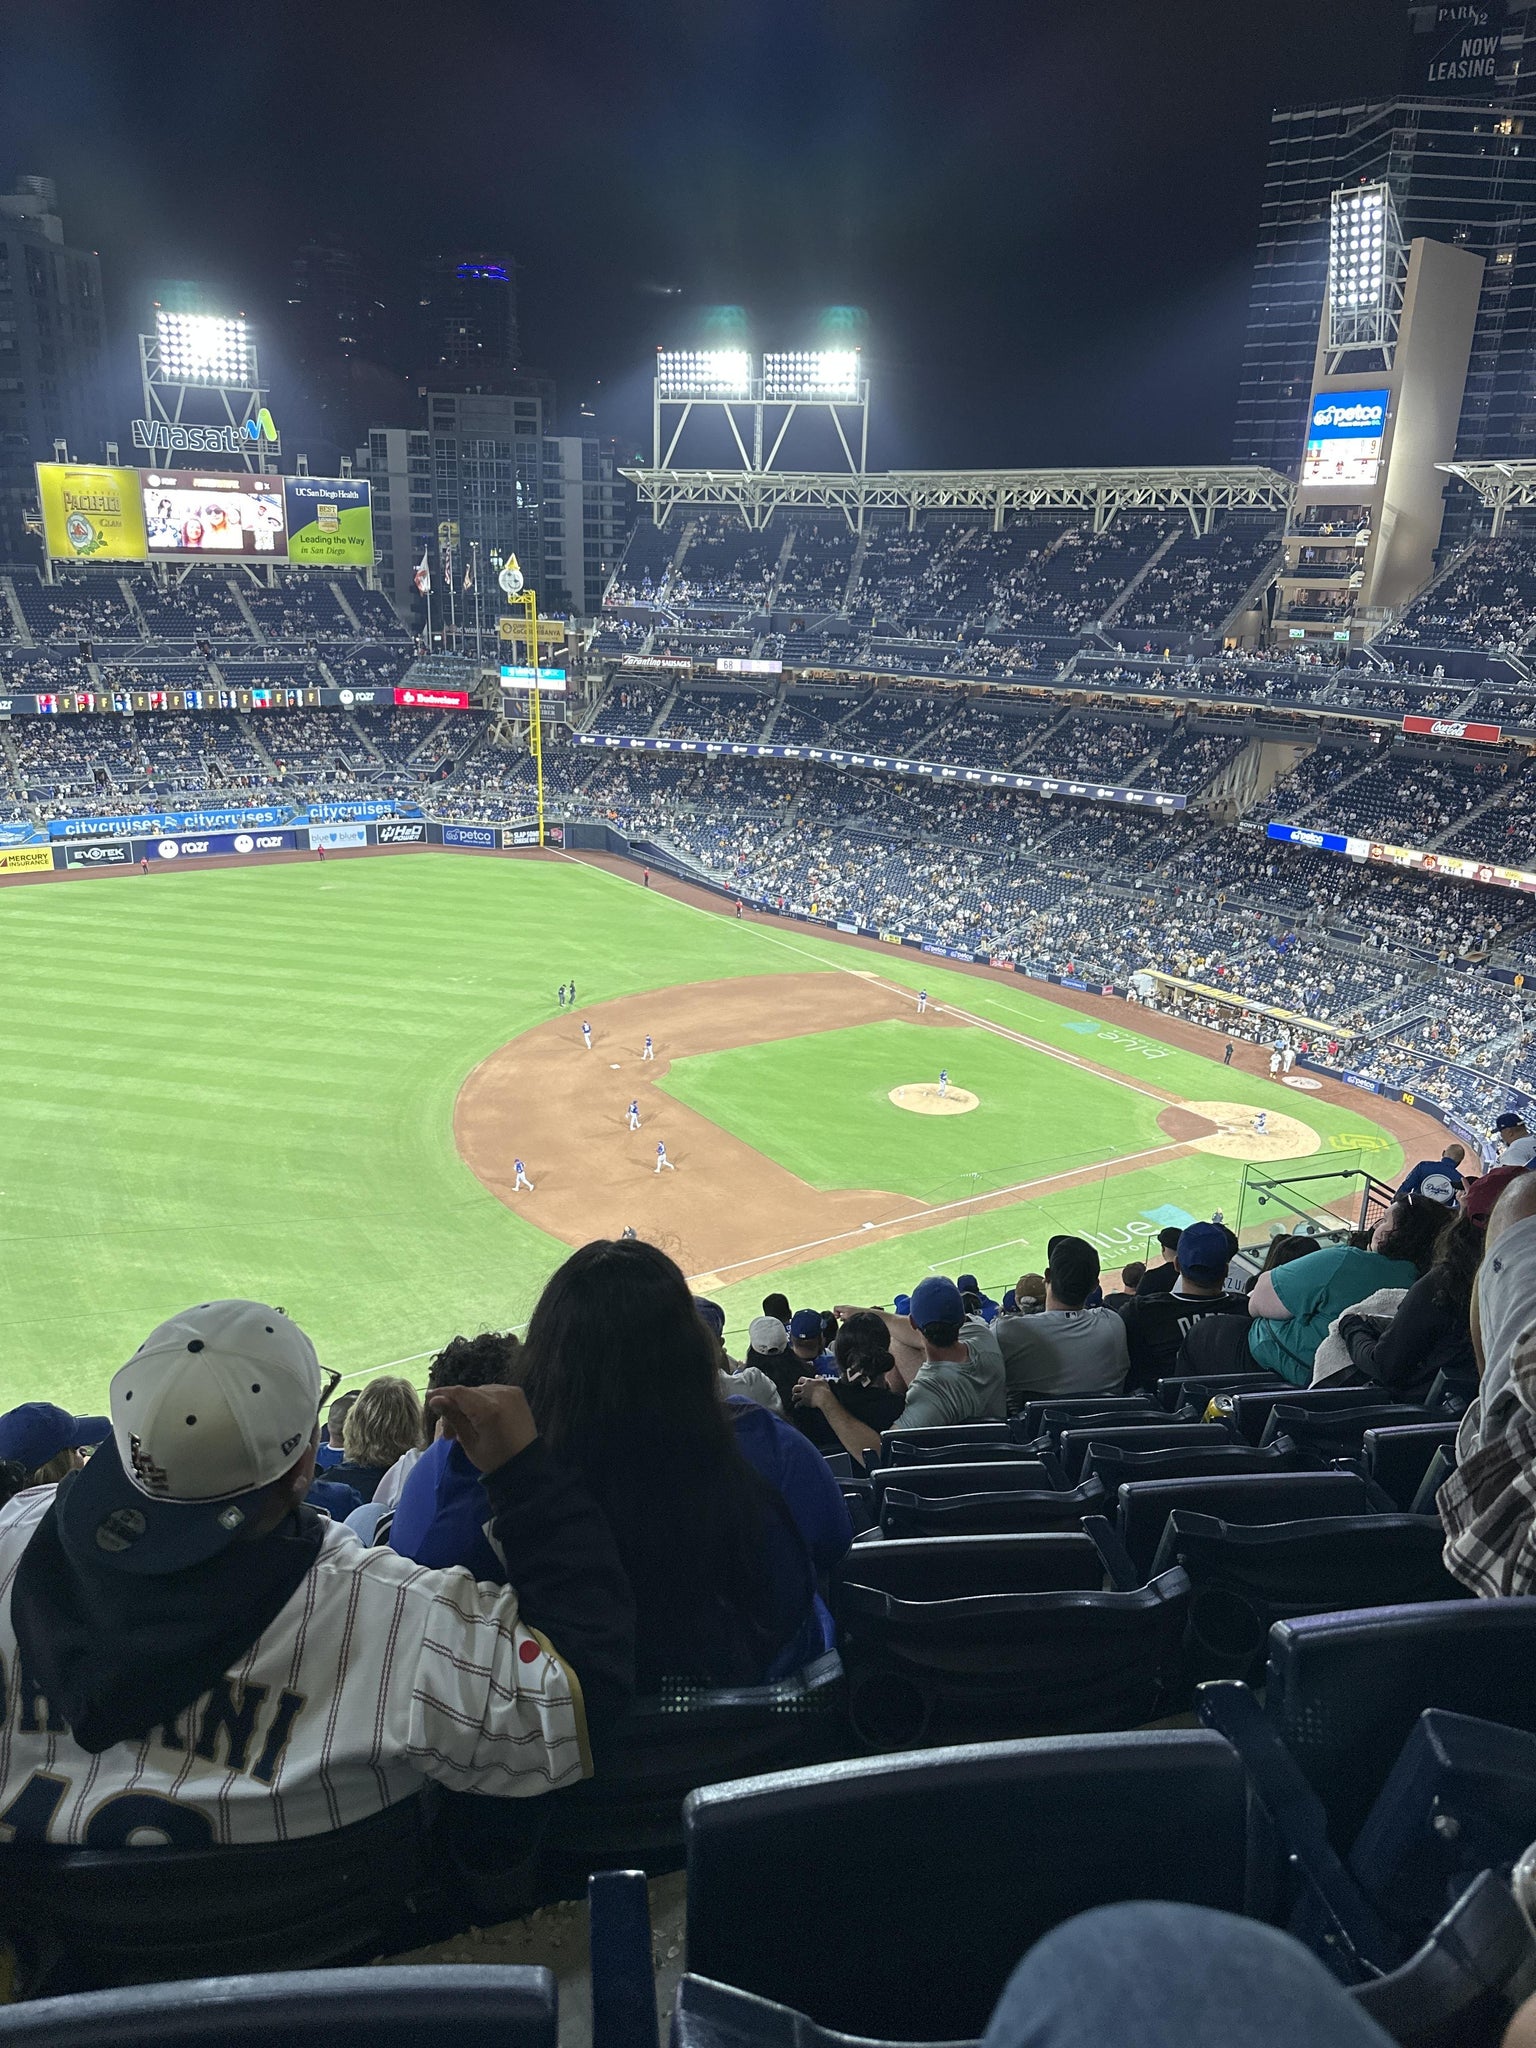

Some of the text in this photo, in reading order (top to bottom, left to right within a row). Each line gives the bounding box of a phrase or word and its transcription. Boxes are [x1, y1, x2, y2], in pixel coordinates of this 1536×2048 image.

[1439, 5, 1478, 21] PARK
[1460, 36, 1499, 58] NOW
[1427, 58, 1495, 82] LEASING
[1333, 404, 1383, 426] petco
[137, 419, 240, 453] Viasat
[295, 488, 359, 499] UC San Diego Health
[300, 535, 365, 546] Leading the Way
[326, 547, 346, 555] Diego
[624, 655, 691, 668] Tarantino SAUSAGES
[723, 660, 734, 670] 68
[355, 691, 375, 701] razr
[416, 694, 460, 705] Budweiser
[1431, 721, 1468, 737] Coca-Cola
[310, 802, 392, 819] citycruises
[312, 833, 329, 842] blue
[340, 832, 357, 841] blue
[392, 834, 420, 842] POWER
[460, 830, 491, 841] petco
[181, 841, 209, 854] razr
[256, 836, 283, 848] razr
[8, 853, 49, 862] MERCURY
[9, 859, 50, 867] INSURANCE
[930, 945, 946, 955] petco
[957, 952, 974, 961] petco
[1097, 1032, 1169, 1060] blue
[1355, 1077, 1375, 1089] petco
[1078, 1221, 1161, 1249] lue
